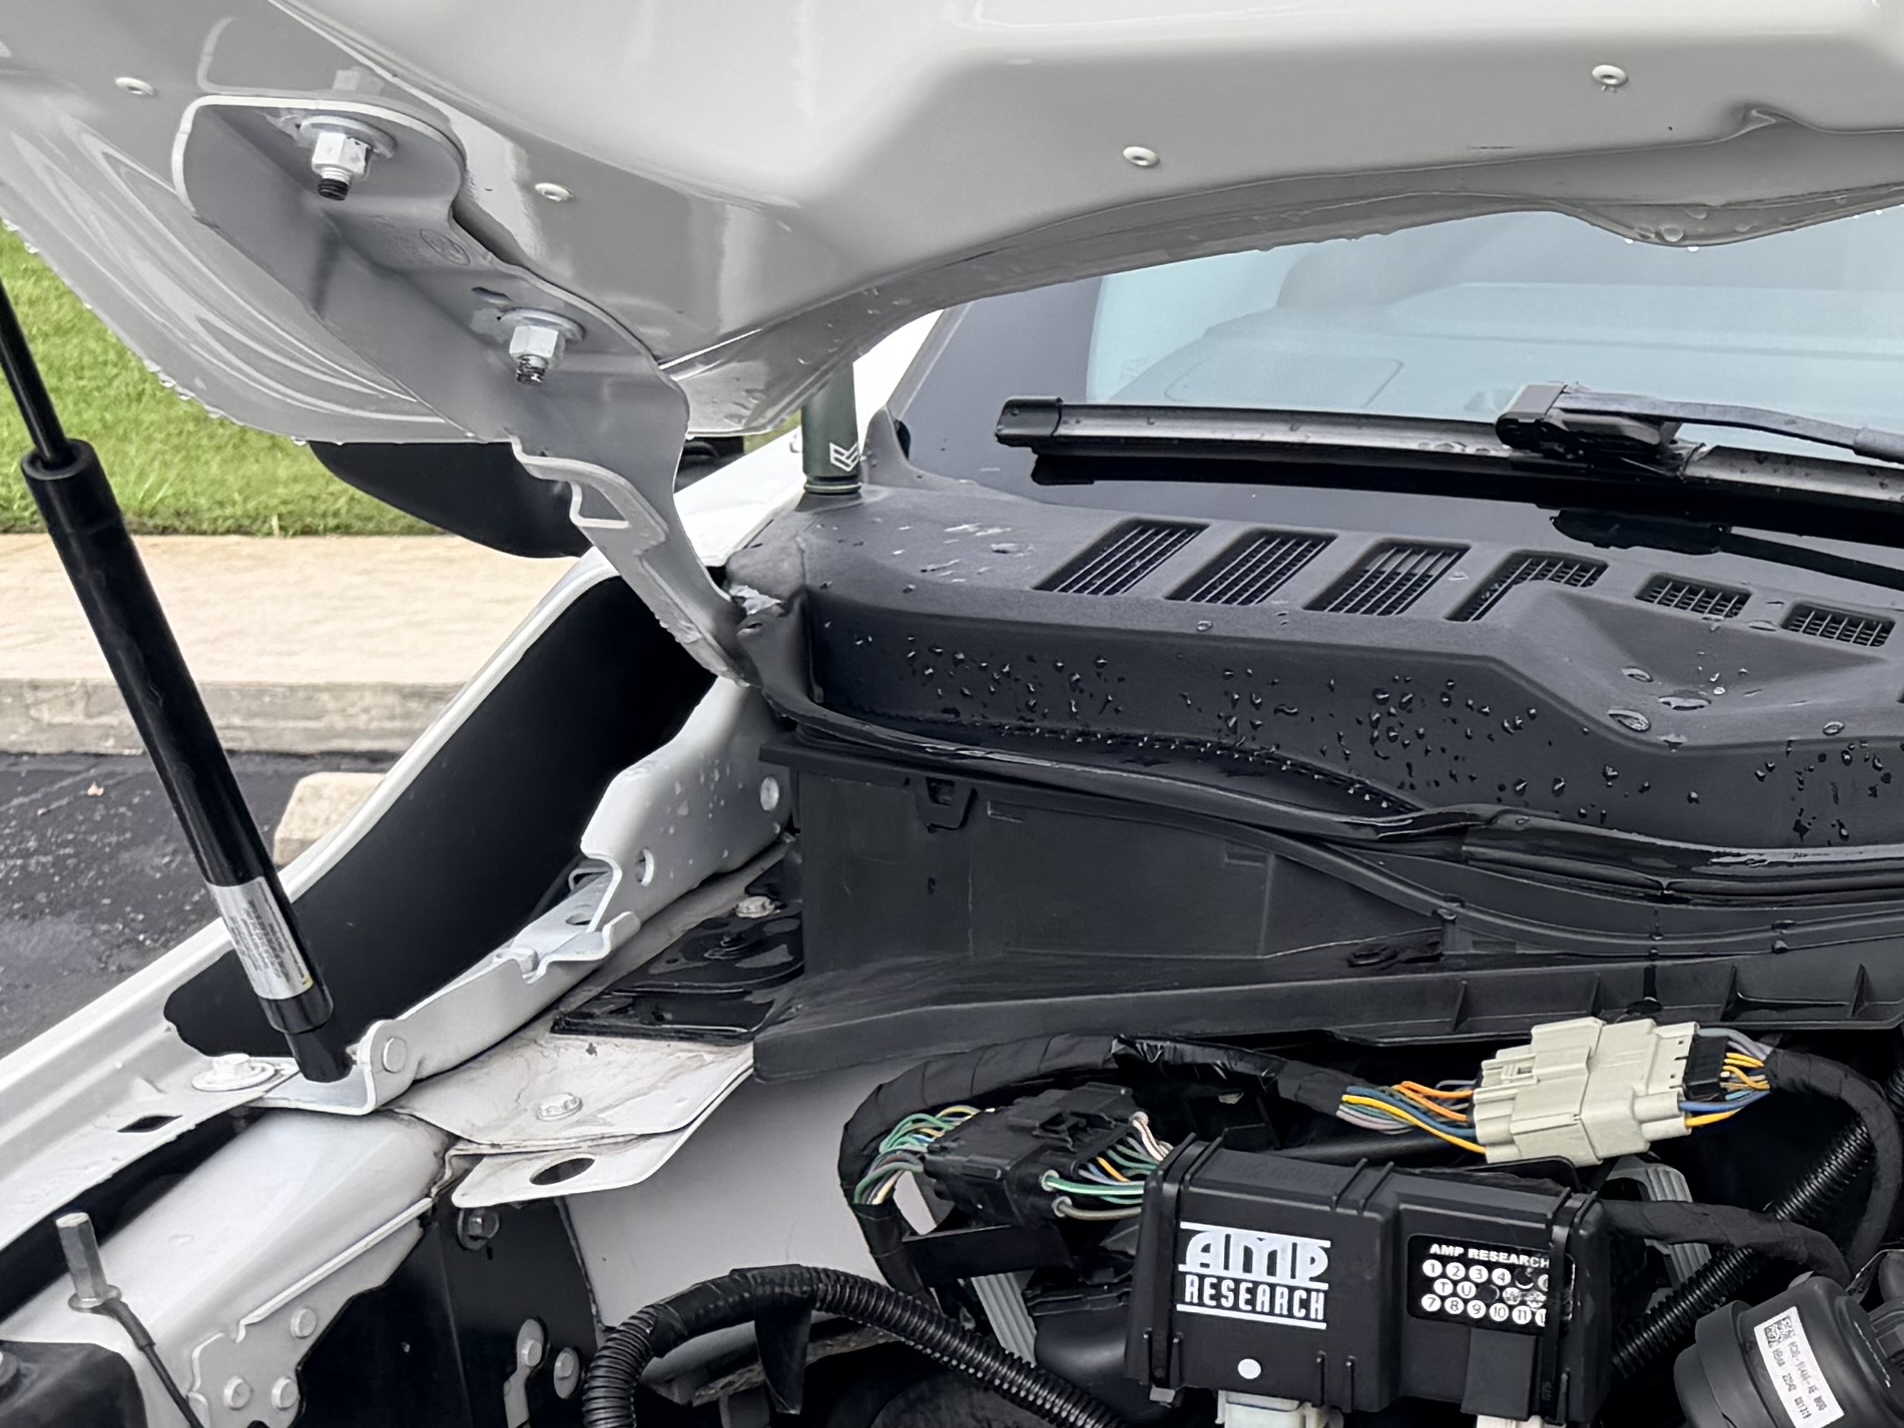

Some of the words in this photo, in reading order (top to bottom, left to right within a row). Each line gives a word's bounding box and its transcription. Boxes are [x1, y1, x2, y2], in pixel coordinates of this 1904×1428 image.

[1185, 1230, 1329, 1285] AMP
[1429, 1243, 1465, 1258] AMP
[1467, 1247, 1550, 1269] RESEARCH
[1184, 1274, 1326, 1321] RESEARCH
